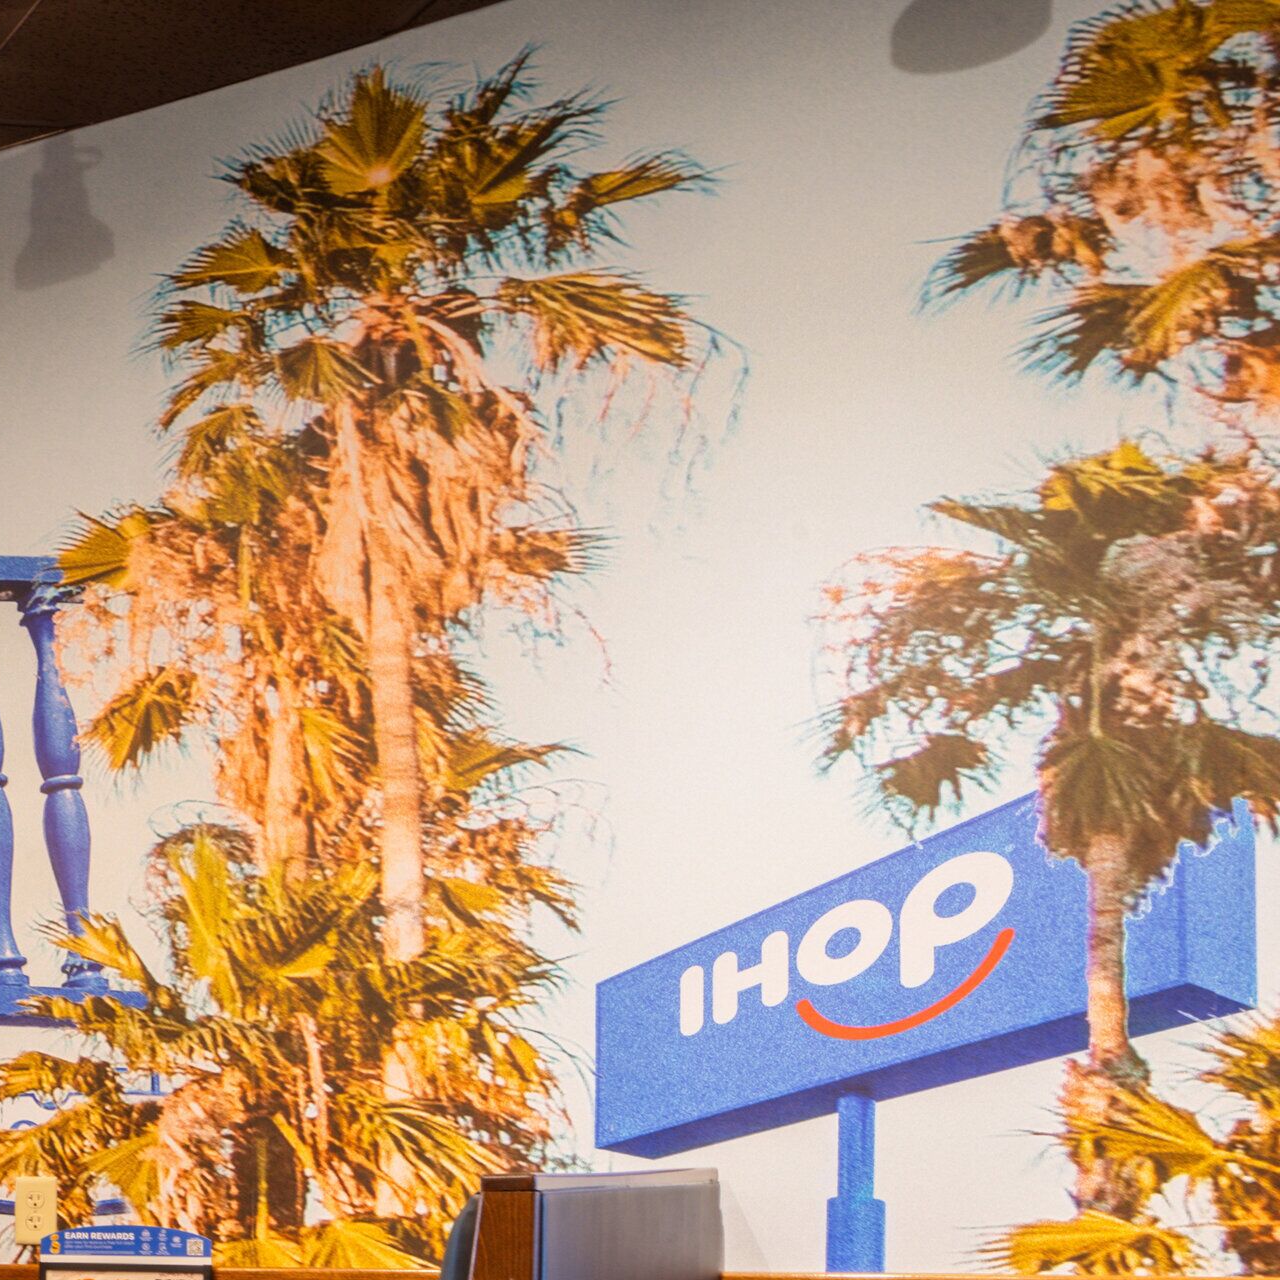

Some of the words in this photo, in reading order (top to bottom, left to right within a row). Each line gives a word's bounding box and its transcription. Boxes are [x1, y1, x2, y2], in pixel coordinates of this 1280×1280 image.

[679, 851, 1015, 1036] IHOP
[64, 1232, 89, 1240] EARN
[90, 1232, 135, 1240] REWARDS
